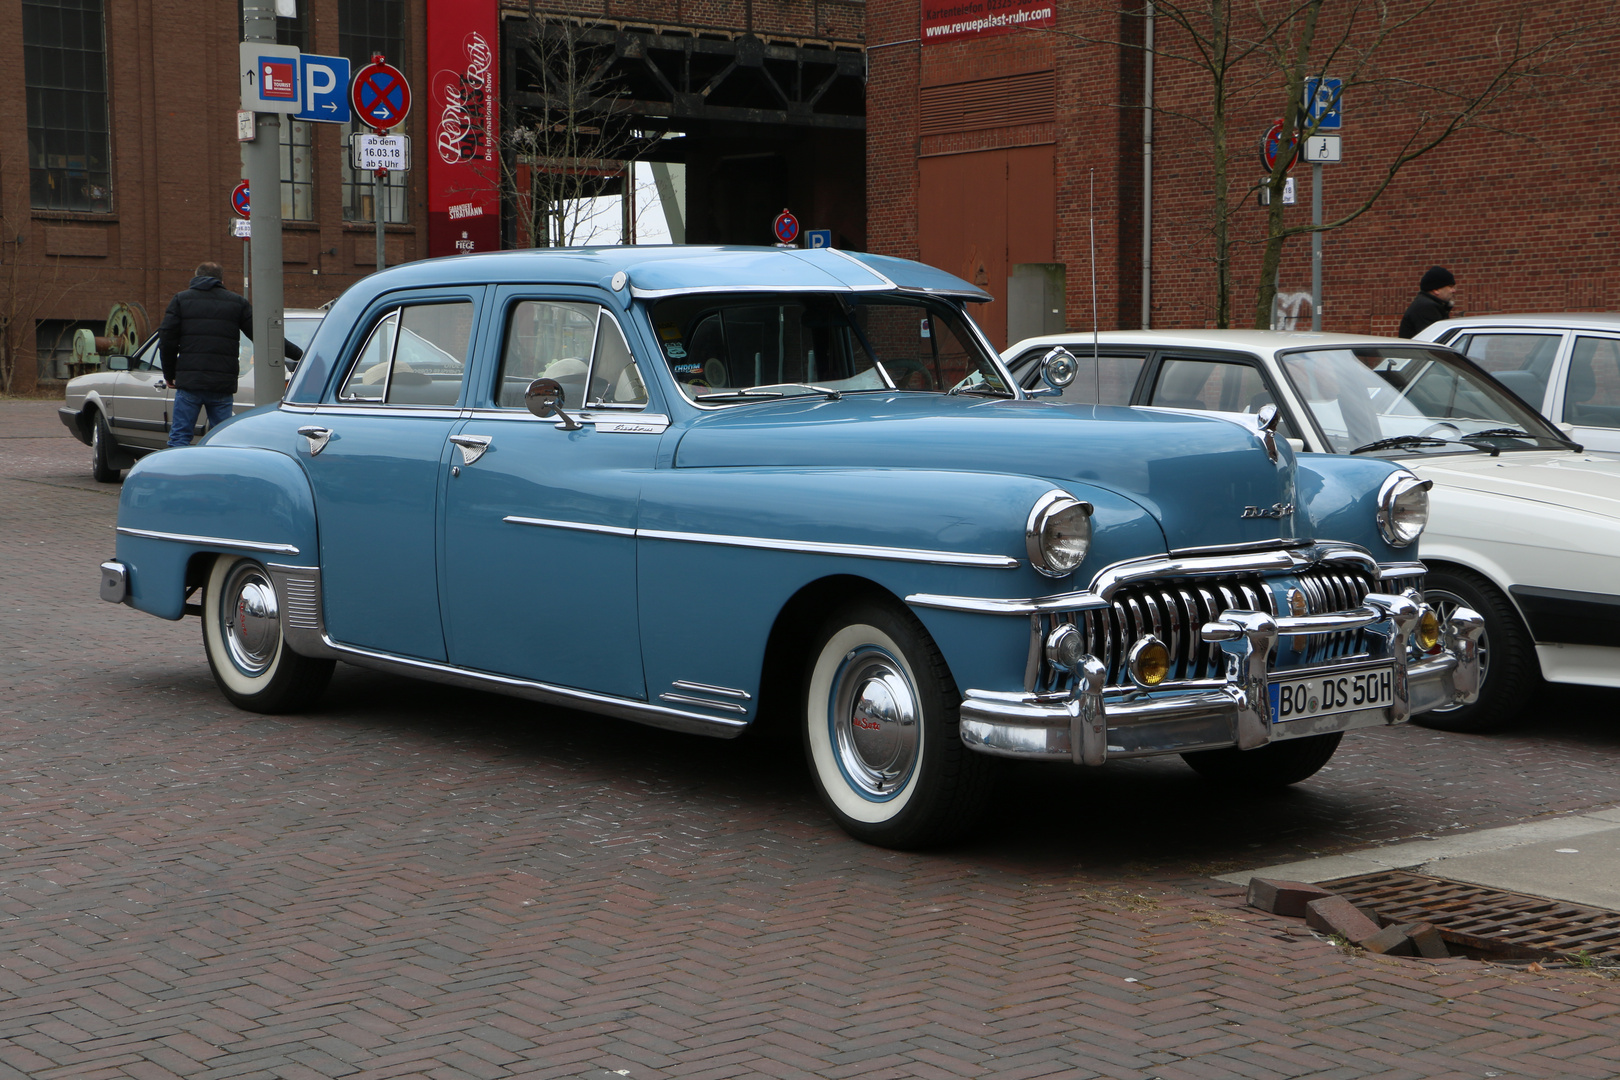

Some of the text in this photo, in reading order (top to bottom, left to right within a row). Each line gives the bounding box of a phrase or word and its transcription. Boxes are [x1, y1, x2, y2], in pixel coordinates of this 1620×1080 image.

[926, 3, 983, 20] Kartentelefon
[926, 8, 1051, 37] www.revuepalast-ruhr.com
[463, 31, 491, 89] Ruhr
[306, 63, 336, 111] P
[435, 82, 471, 164] Revue
[460, 73, 484, 160] PALAST
[364, 147, 400, 158] 16.03.18
[368, 137, 397, 146] ab dem
[366, 160, 399, 168] ab 5 Uhr
[449, 206, 483, 220] STRATMANN
[1280, 671, 1392, 717] BO DS 50H
